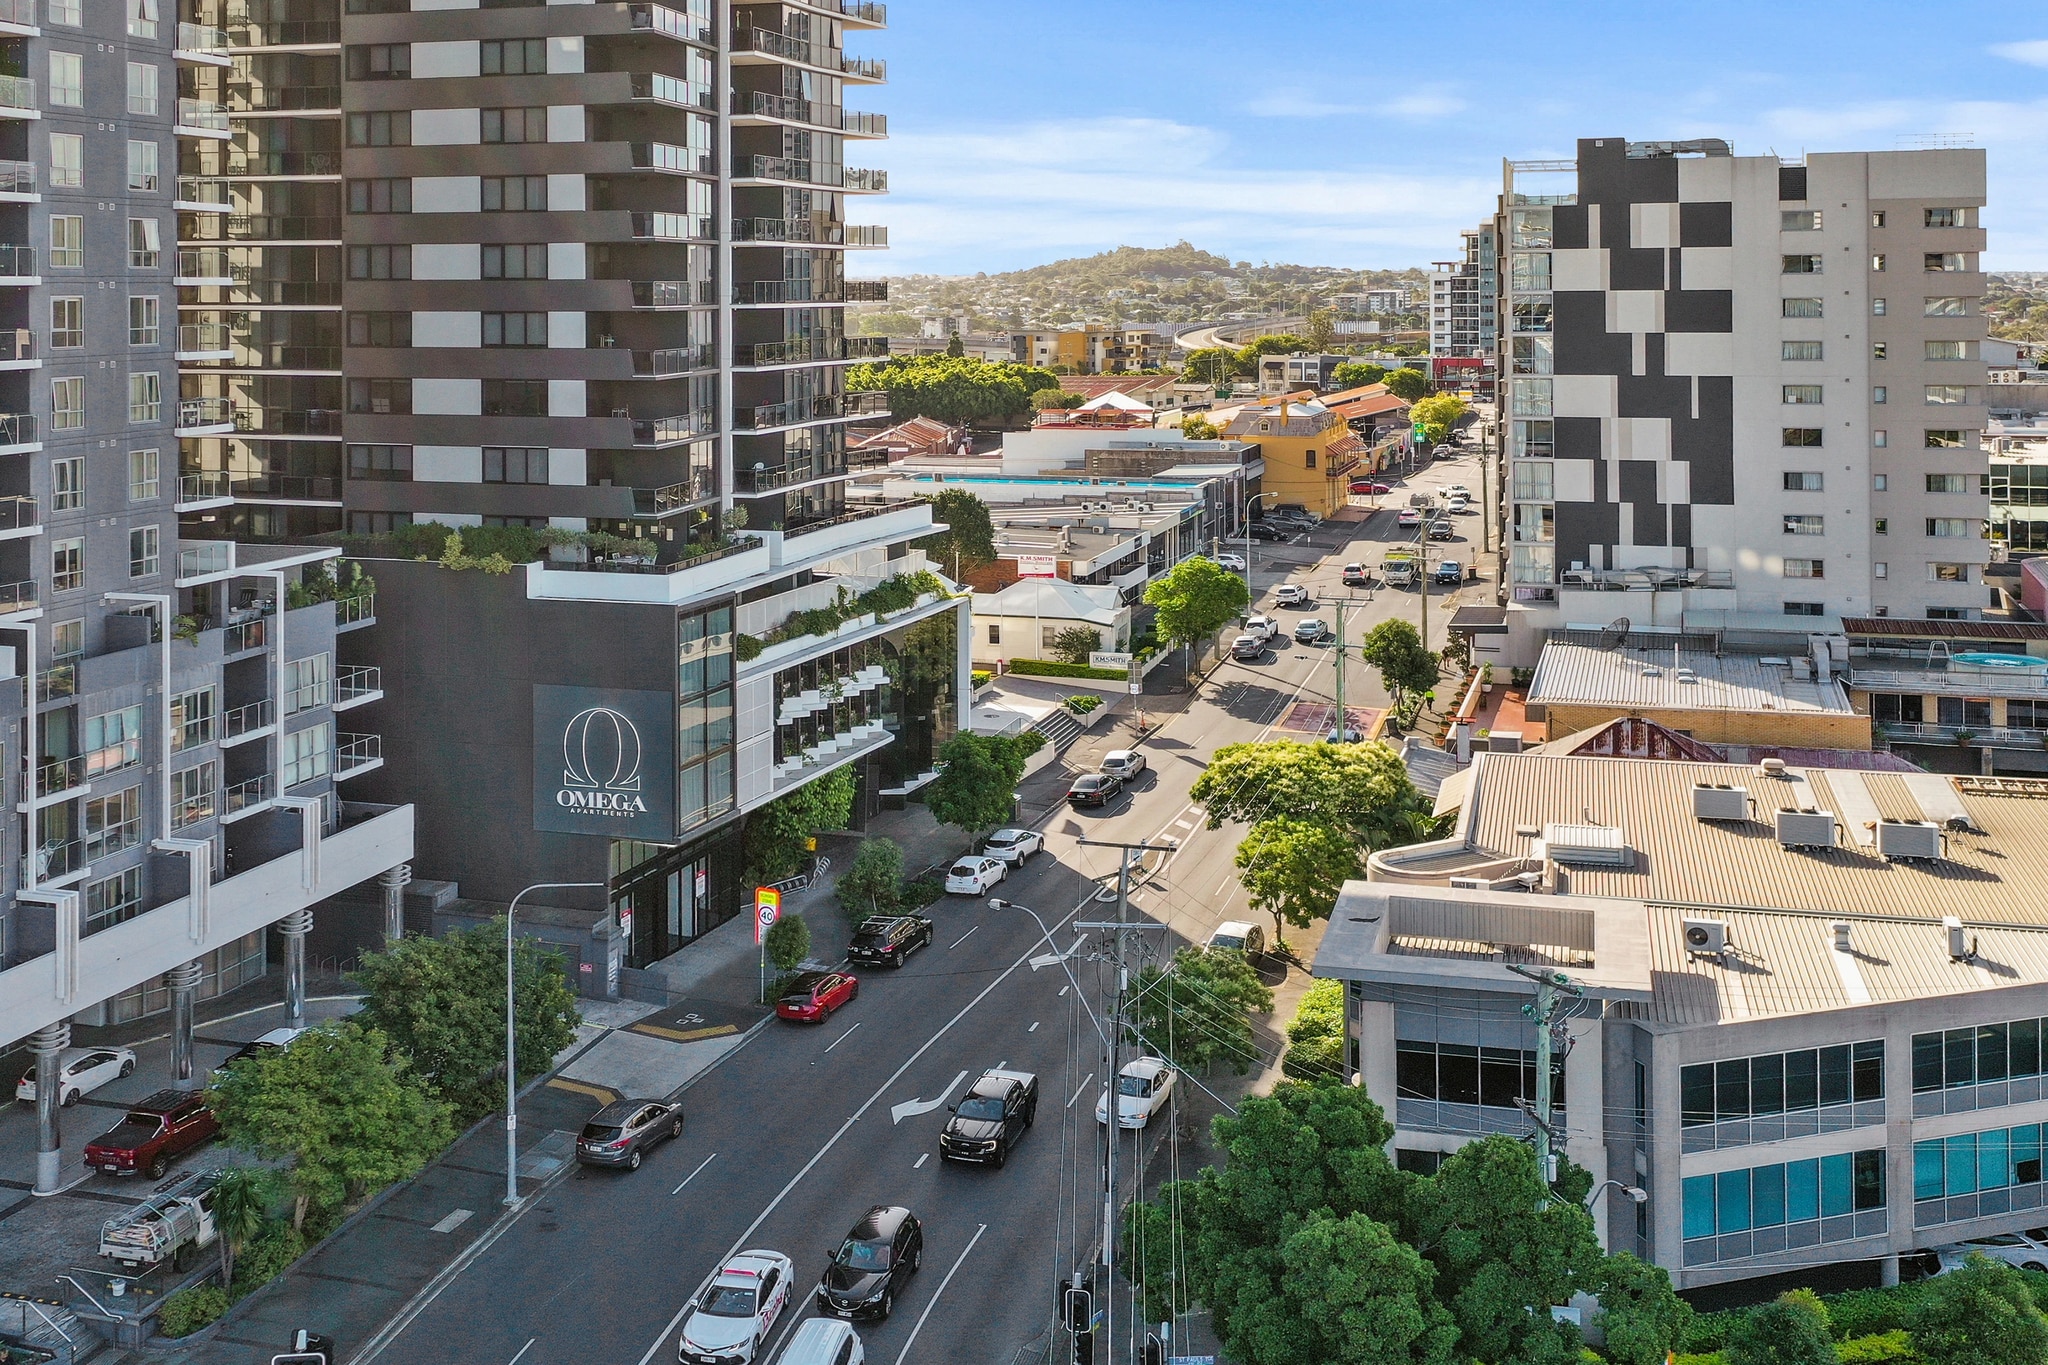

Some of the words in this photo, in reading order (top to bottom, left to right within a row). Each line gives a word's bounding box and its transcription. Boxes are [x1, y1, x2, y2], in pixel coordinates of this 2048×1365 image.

[556, 789, 648, 813] OMEGA
[570, 807, 635, 818] APARTMENTS
[761, 911, 773, 921] 40
[95, 1154, 122, 1164] TOYOTA
